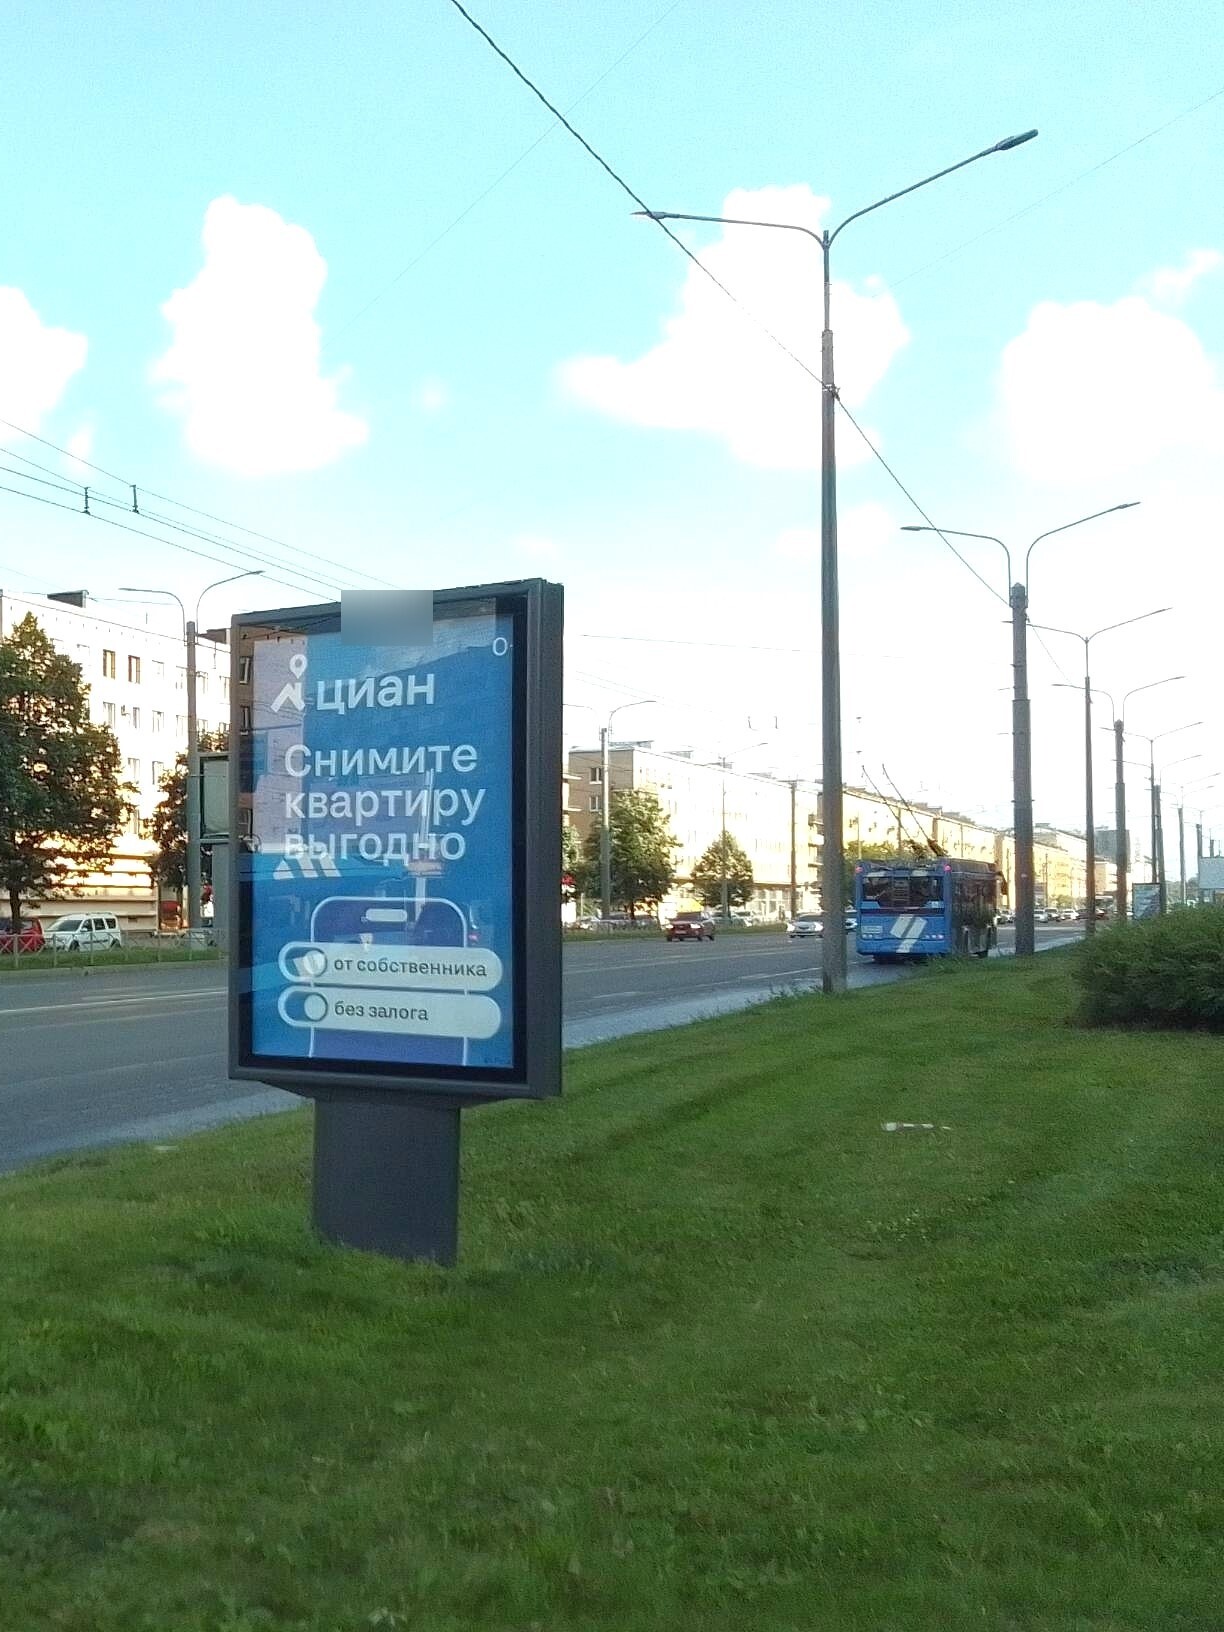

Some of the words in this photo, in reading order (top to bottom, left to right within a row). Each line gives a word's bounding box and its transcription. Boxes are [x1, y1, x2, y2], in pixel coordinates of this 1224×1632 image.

[317, 673, 435, 715] циан
[284, 744, 477, 777] Снимите
[285, 788, 486, 826] квартиру
[284, 832, 466, 867] выгодно
[334, 959, 353, 971] от
[357, 957, 487, 977] собственника
[334, 1001, 365, 1016] без
[368, 1005, 428, 1021] залога
